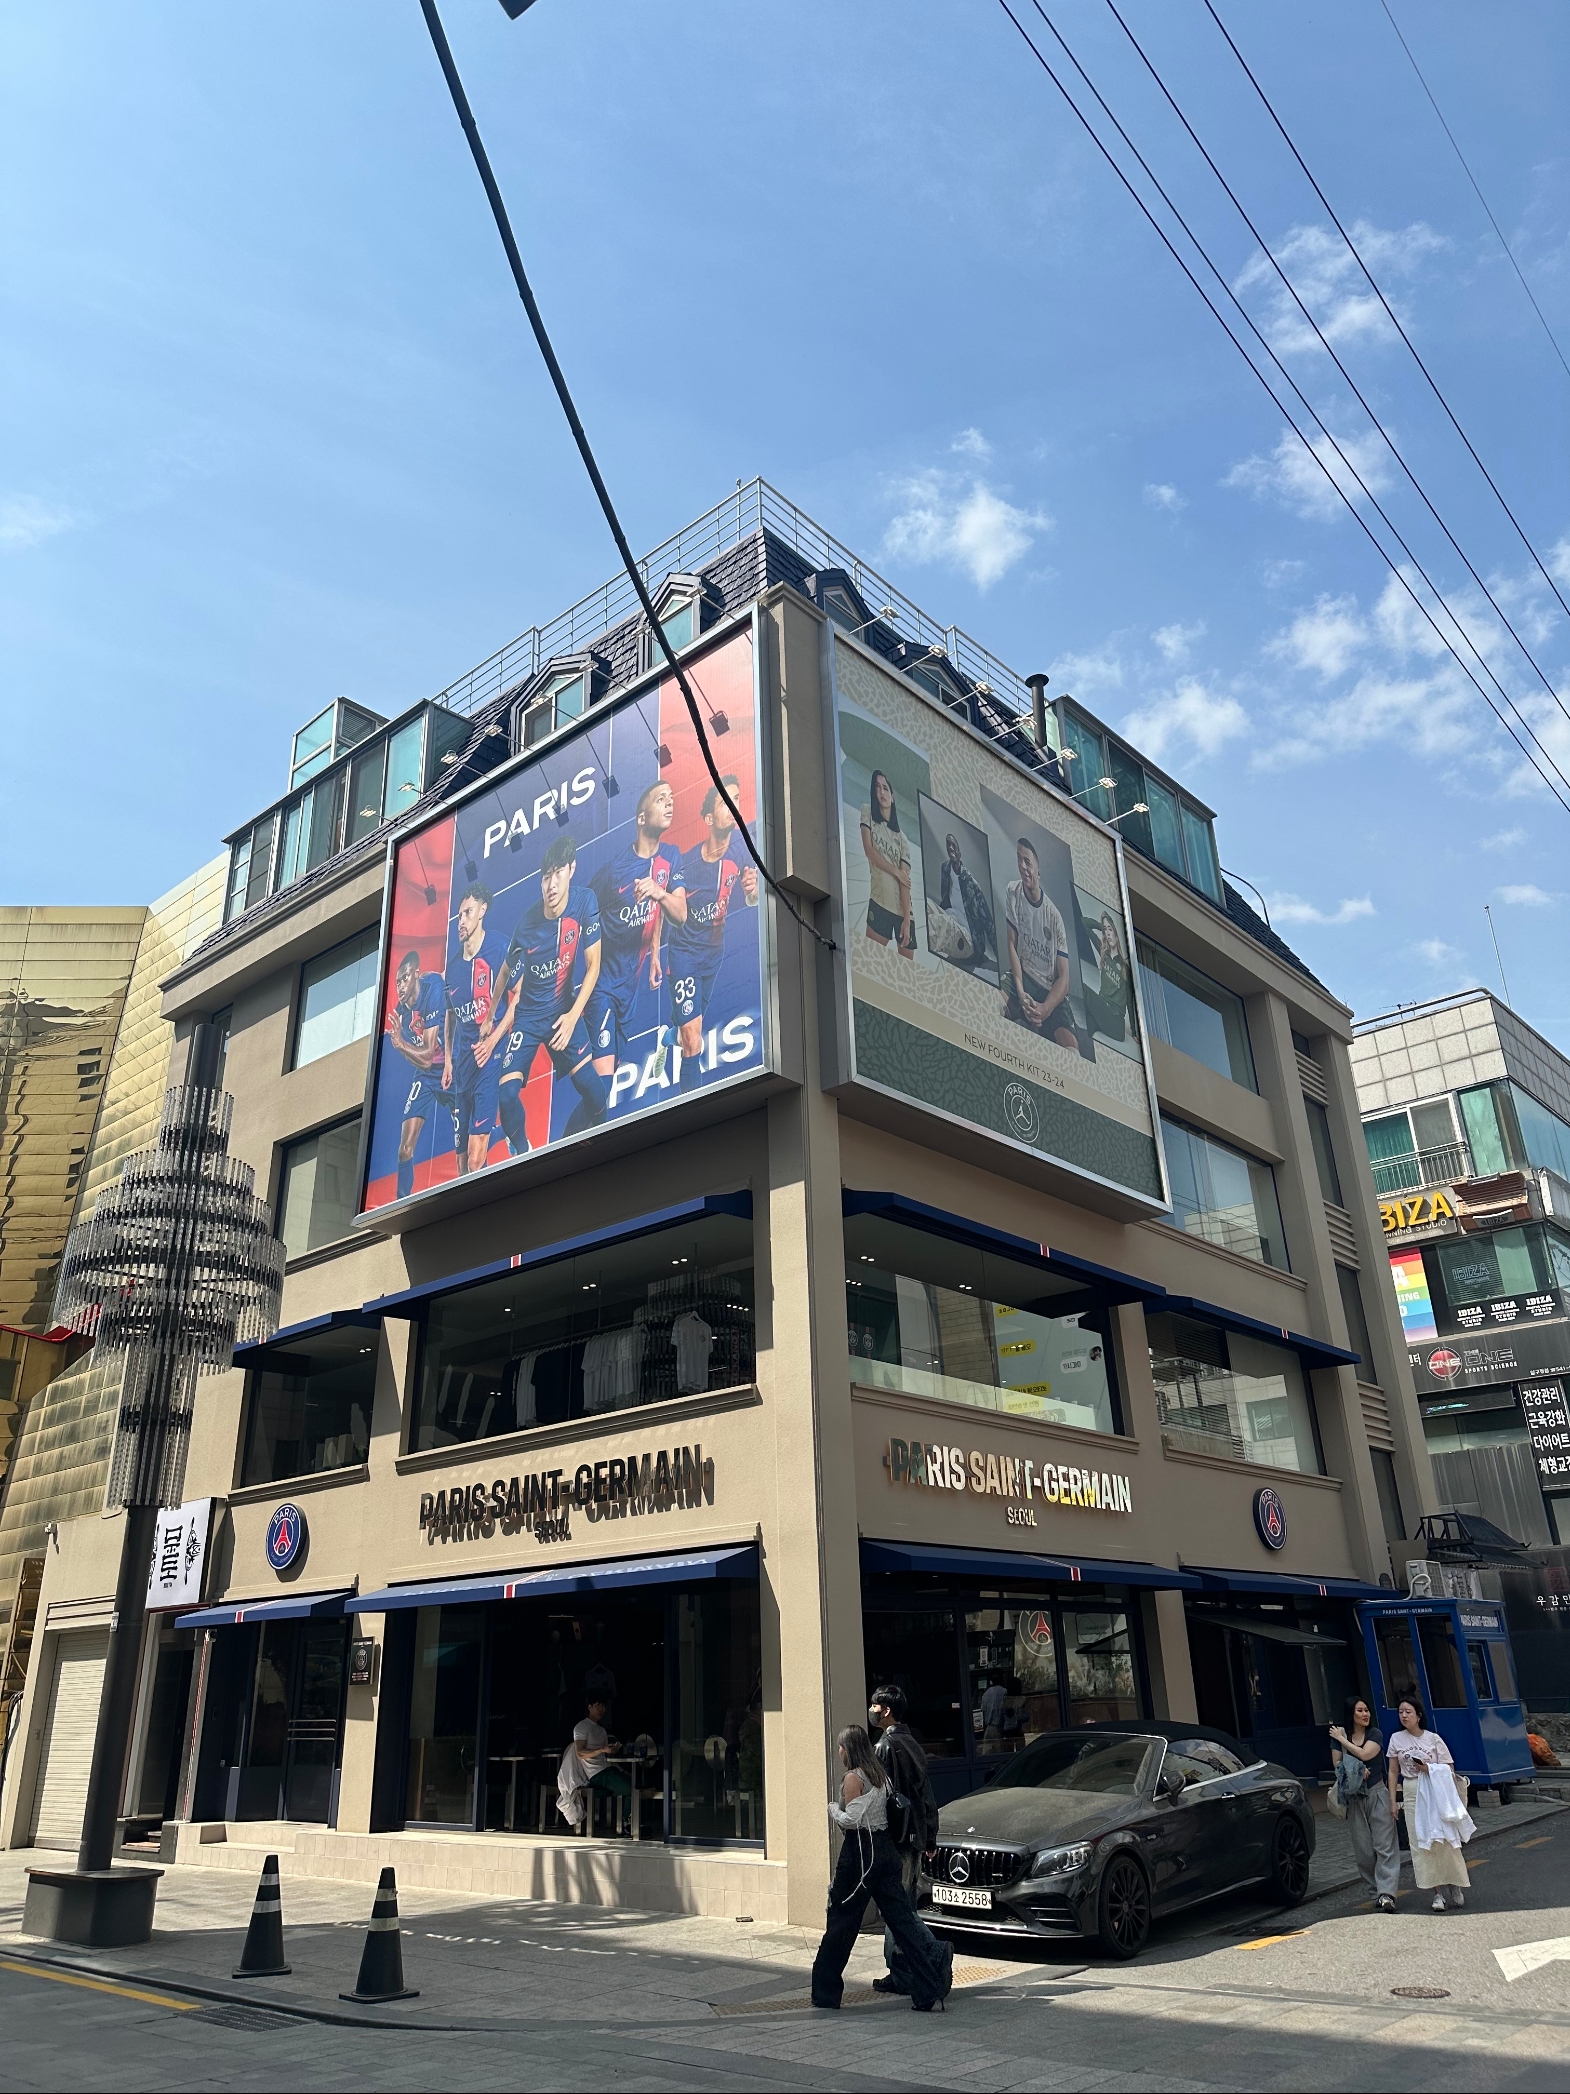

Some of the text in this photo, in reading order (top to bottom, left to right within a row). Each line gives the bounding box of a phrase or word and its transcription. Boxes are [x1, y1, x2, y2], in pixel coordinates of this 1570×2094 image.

[483, 766, 596, 859] PARIS
[531, 953, 570, 976] QATAR
[674, 976, 696, 1004] 33
[454, 996, 486, 1018] QATAR
[505, 1030, 524, 1053] 19
[964, 1033, 1065, 1089] NEW FOURTH KIT 23-24
[1007, 1085, 1032, 1105] PARIS
[1415, 1219, 1447, 1232] STUDIO
[1451, 1263, 1490, 1282] IBIZA
[1490, 1300, 1517, 1312] IBIZA
[1526, 1294, 1553, 1306] IBIZA
[1457, 1306, 1483, 1318] IBIZA
[1428, 1357, 1462, 1370] ONE
[1464, 1348, 1514, 1367] ONE
[1464, 1360, 1518, 1374] SPORTS SCIENCE
[1523, 1386, 1561, 1406] 건강관리
[1528, 1409, 1566, 1429] 근육강화
[1533, 1432, 1570, 1451] 다이어트
[419, 1444, 703, 1525] PARIS SAINT-GERMAIN
[890, 1437, 1133, 1514] PARIS SAINT-GERMAIN
[1261, 1491, 1280, 1508] PARIS
[272, 1507, 297, 1525] PARIS
[1007, 1506, 1038, 1527] SEOUL
[535, 1517, 570, 1539] SEOUL
[936, 1888, 988, 1906] 103소 2558
